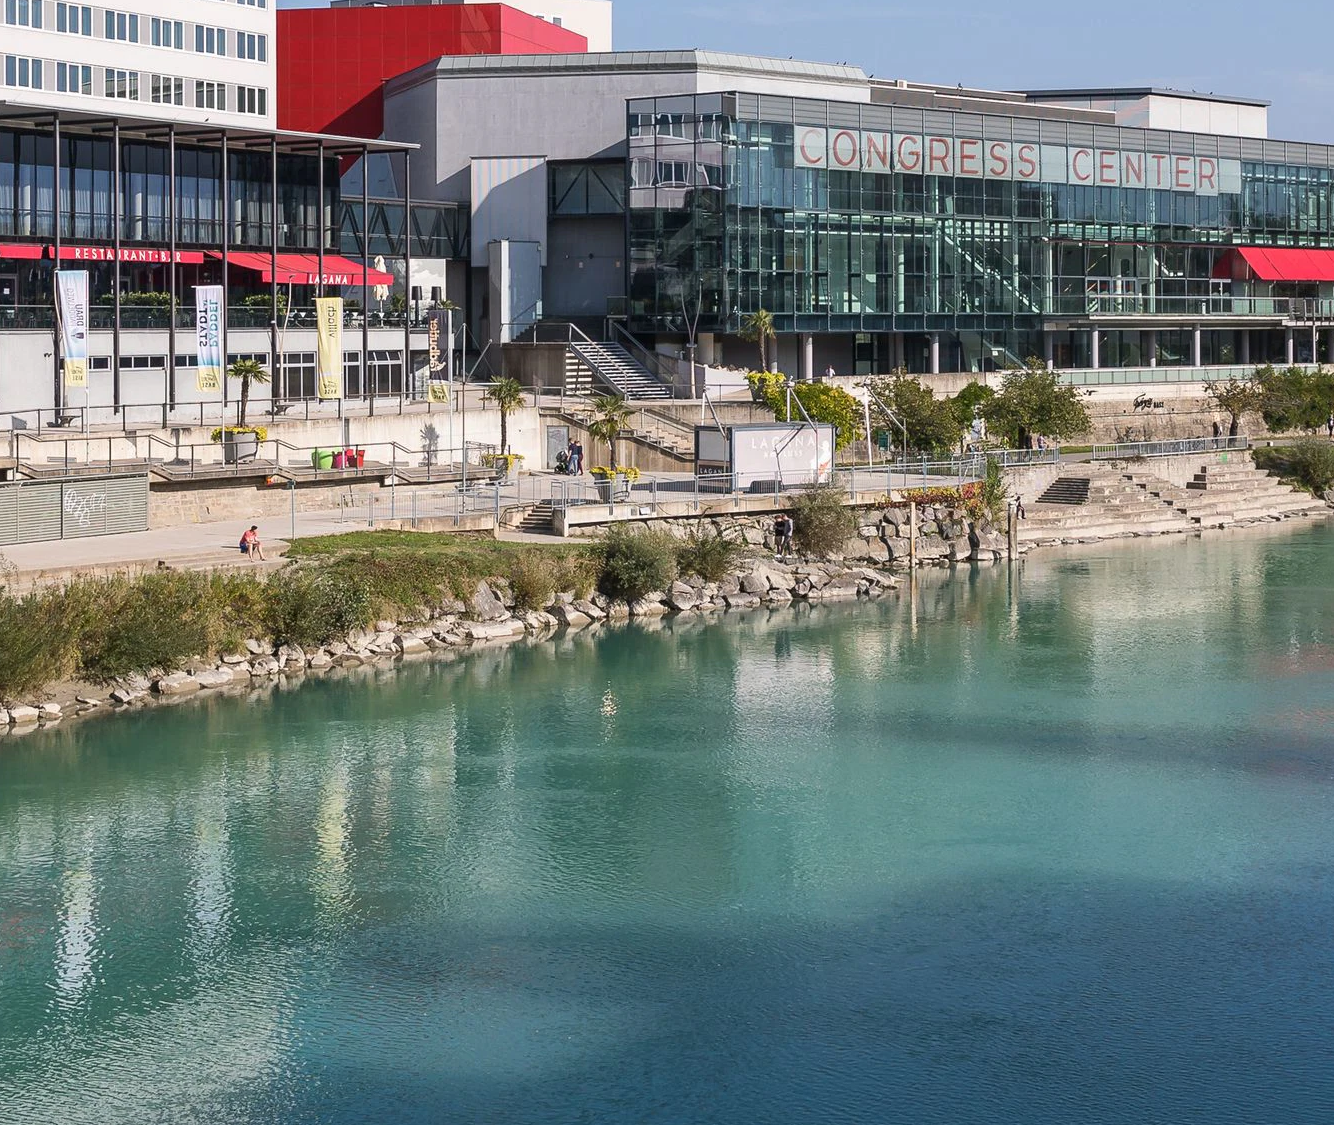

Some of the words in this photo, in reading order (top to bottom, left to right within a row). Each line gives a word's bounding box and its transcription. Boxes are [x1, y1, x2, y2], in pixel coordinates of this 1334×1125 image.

[800, 129, 1037, 177] CONGRESS
[1073, 148, 1216, 189] CENTER
[161, 251, 181, 263] BR
